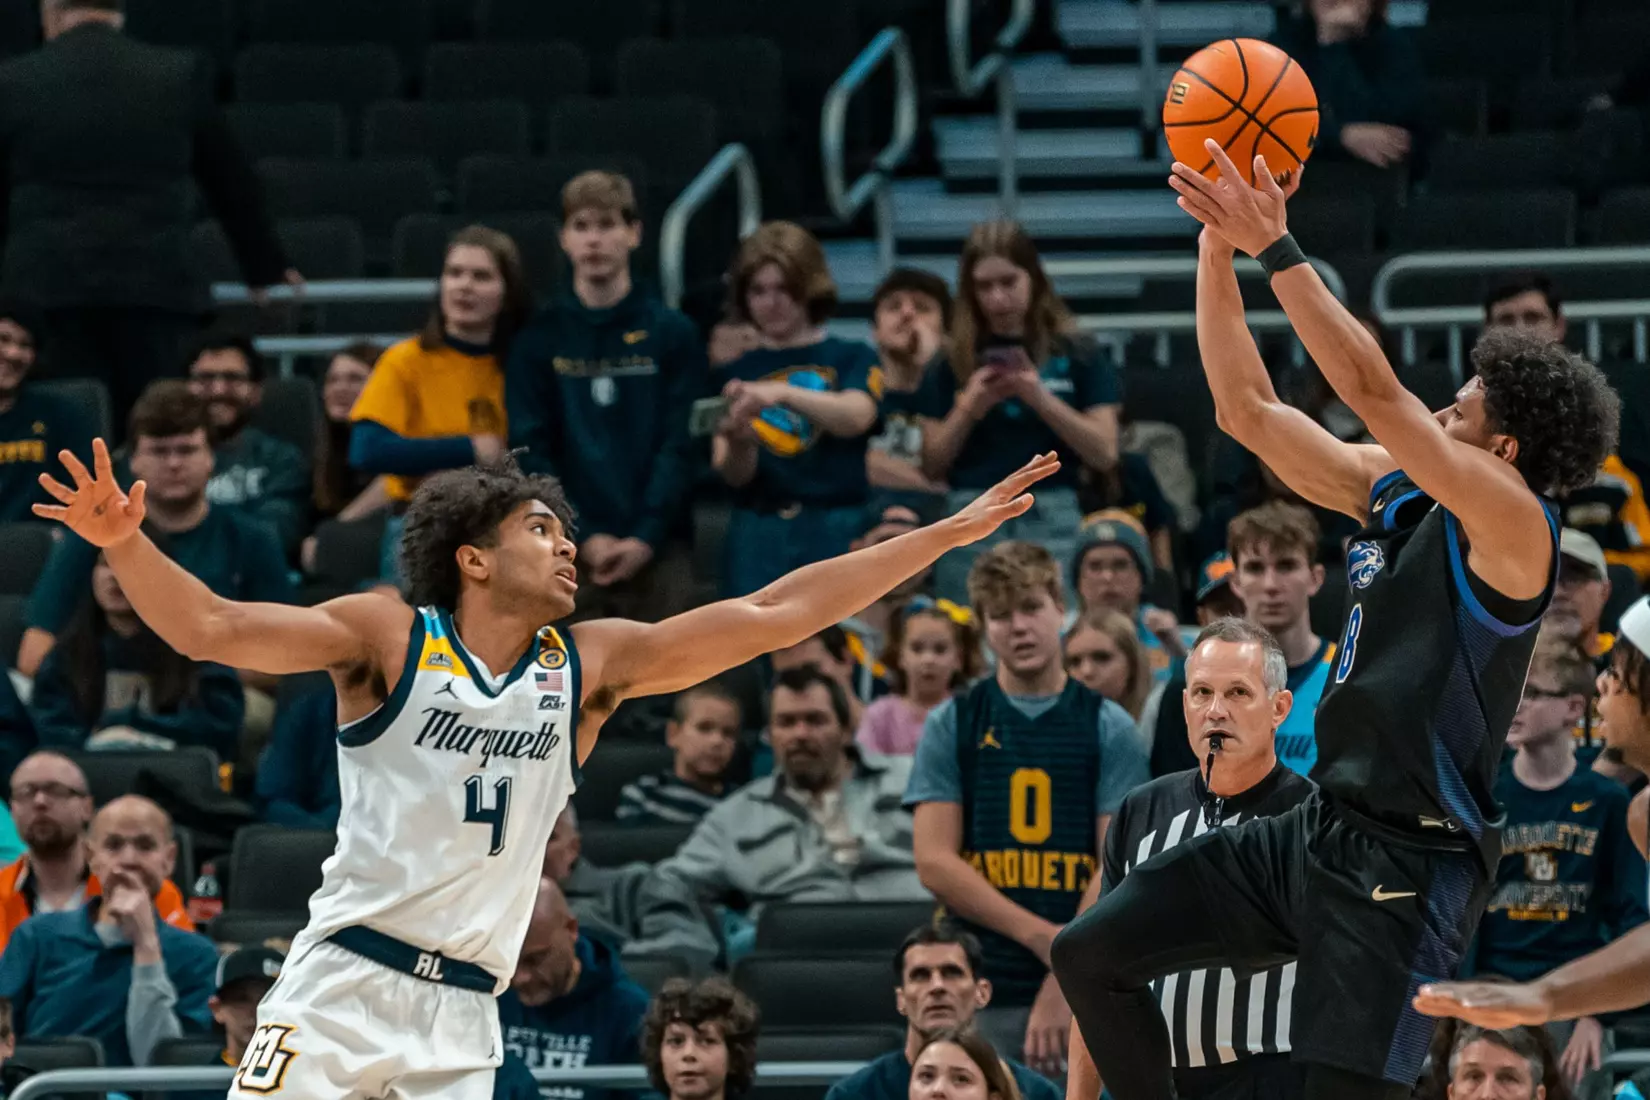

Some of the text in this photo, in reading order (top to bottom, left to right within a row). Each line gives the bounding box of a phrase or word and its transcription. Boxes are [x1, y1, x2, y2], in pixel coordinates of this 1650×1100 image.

[1335, 603, 1363, 684] 8
[413, 707, 561, 769] Marquette
[537, 701, 567, 711] EAST
[462, 774, 513, 857] 4
[1009, 767, 1053, 845] 0
[412, 952, 444, 981] AL
[237, 1023, 300, 1096] MU
